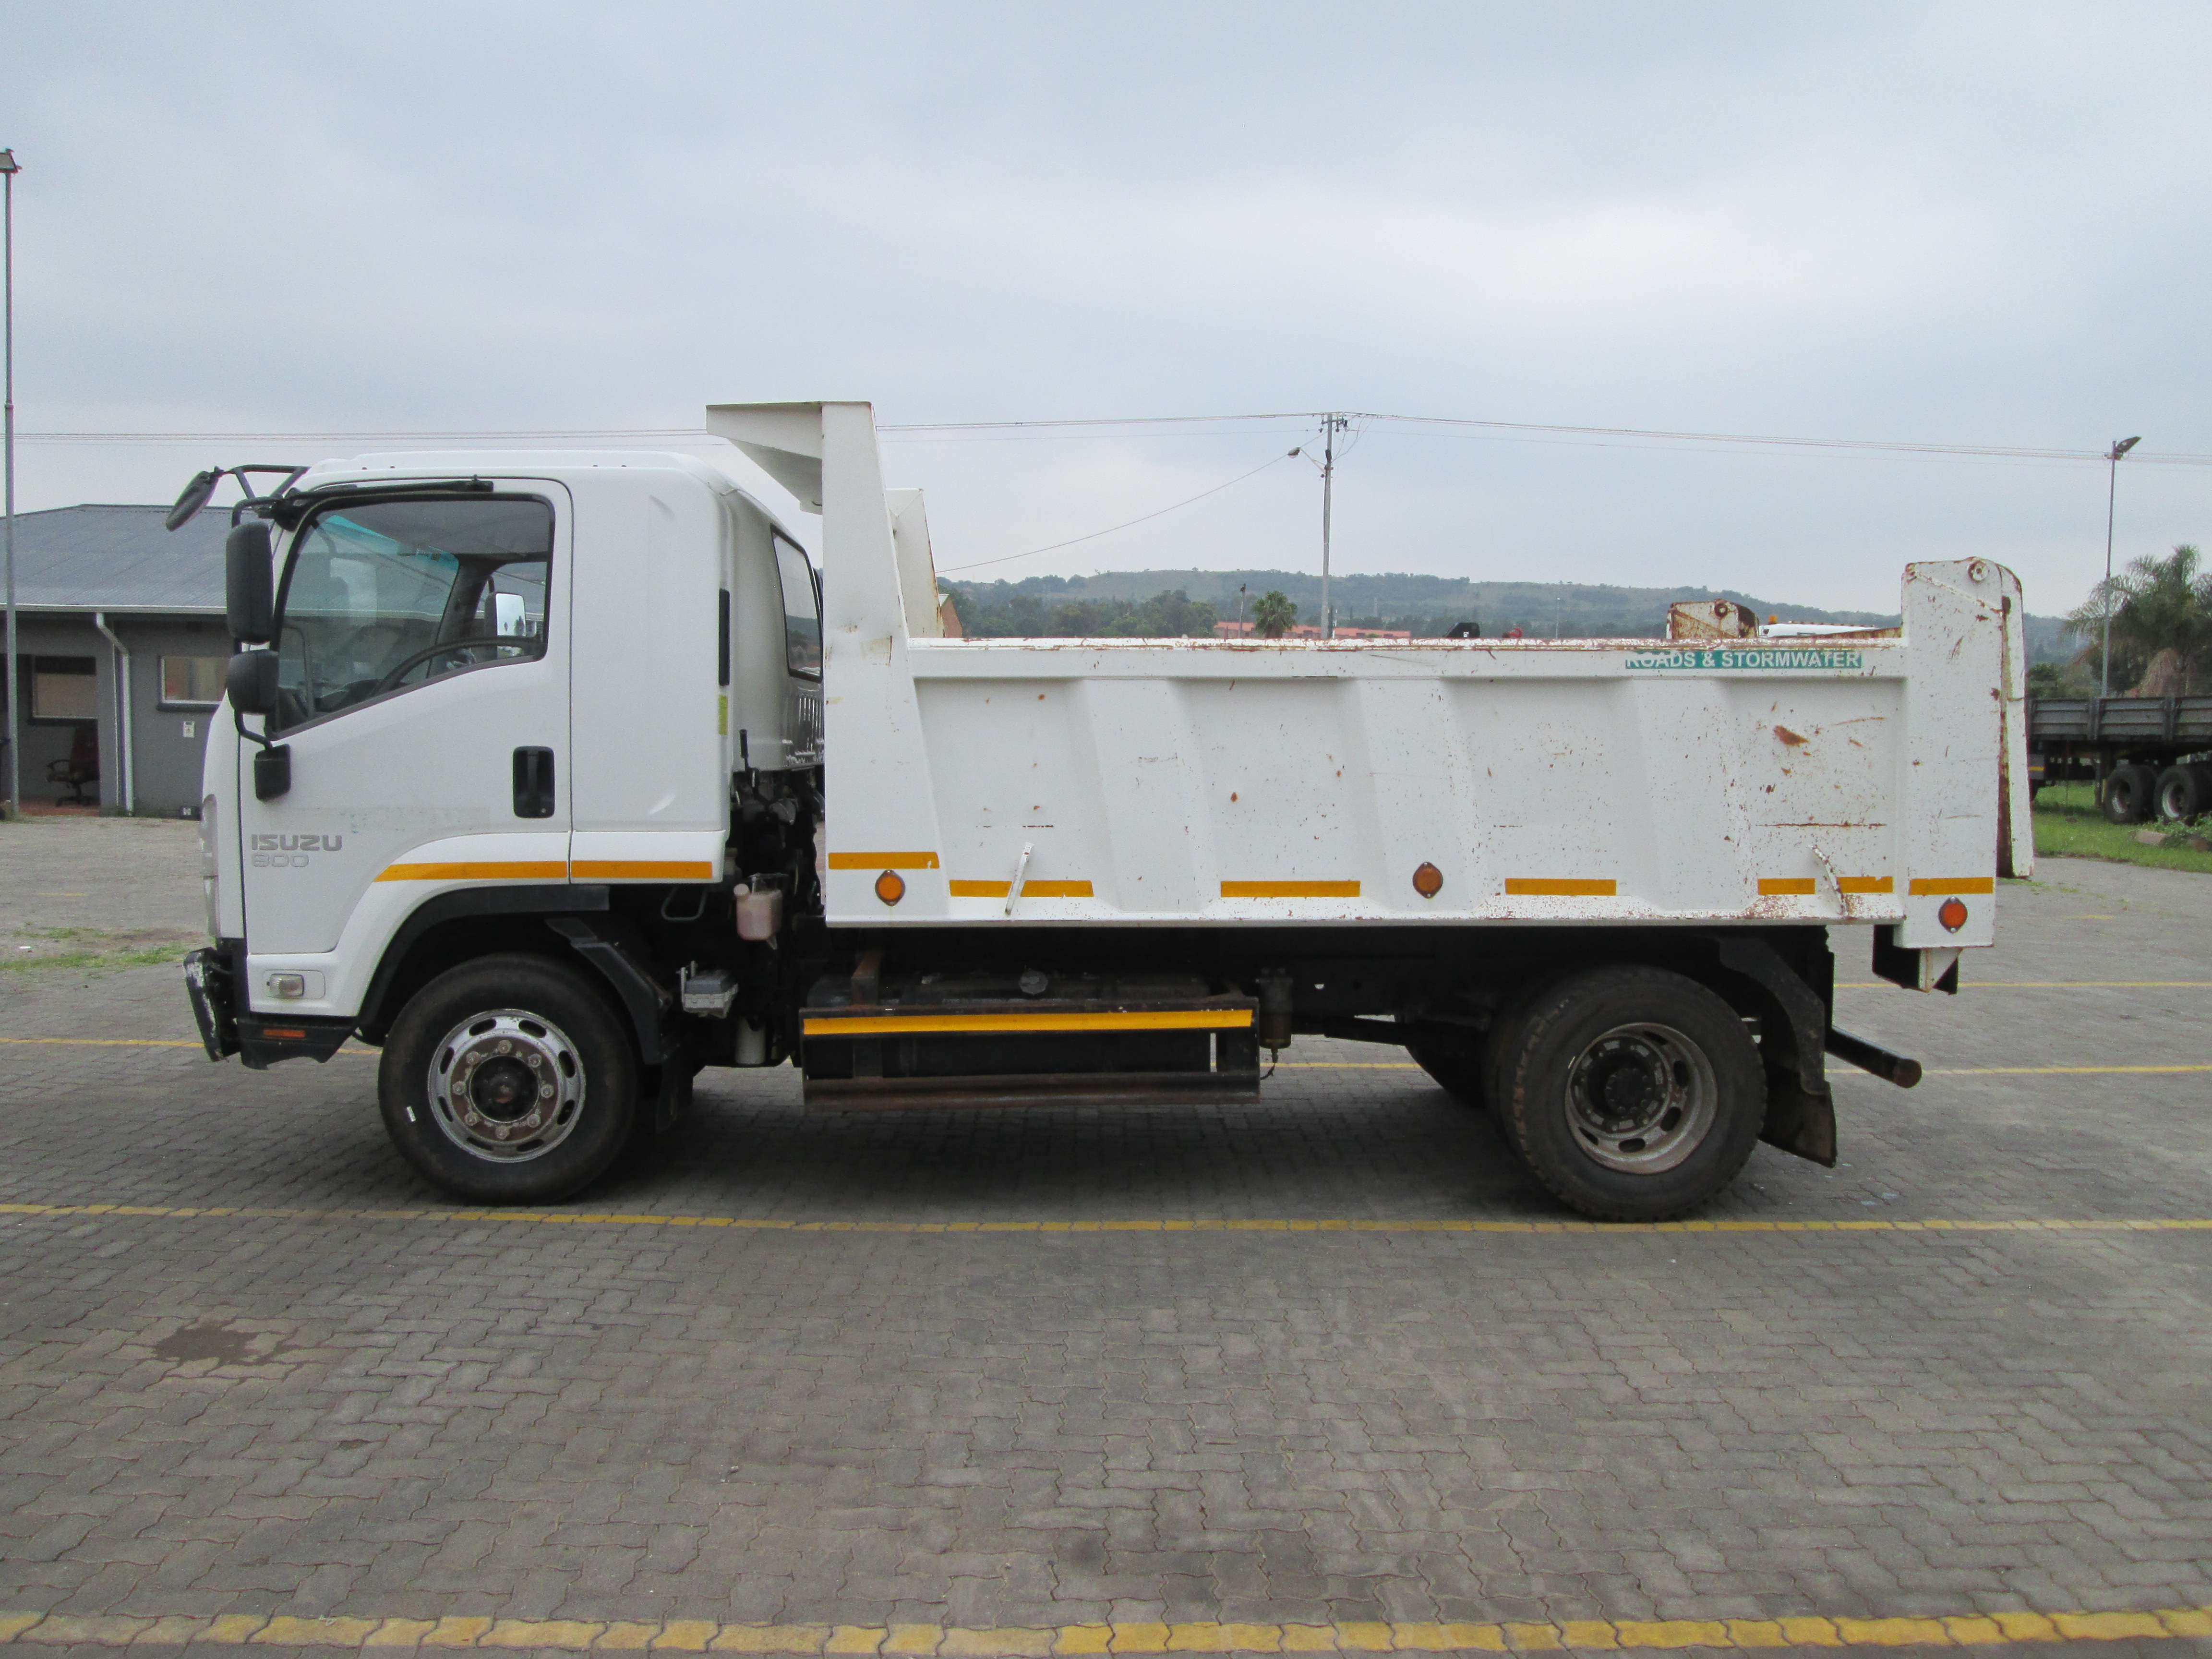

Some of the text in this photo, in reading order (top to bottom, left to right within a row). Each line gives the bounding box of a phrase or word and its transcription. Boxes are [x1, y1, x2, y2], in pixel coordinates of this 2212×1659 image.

[1703, 651, 1715, 667] &
[1721, 651, 1860, 667] STORMWATER
[251, 834, 342, 851] ISUZU
[252, 853, 309, 867] 800
